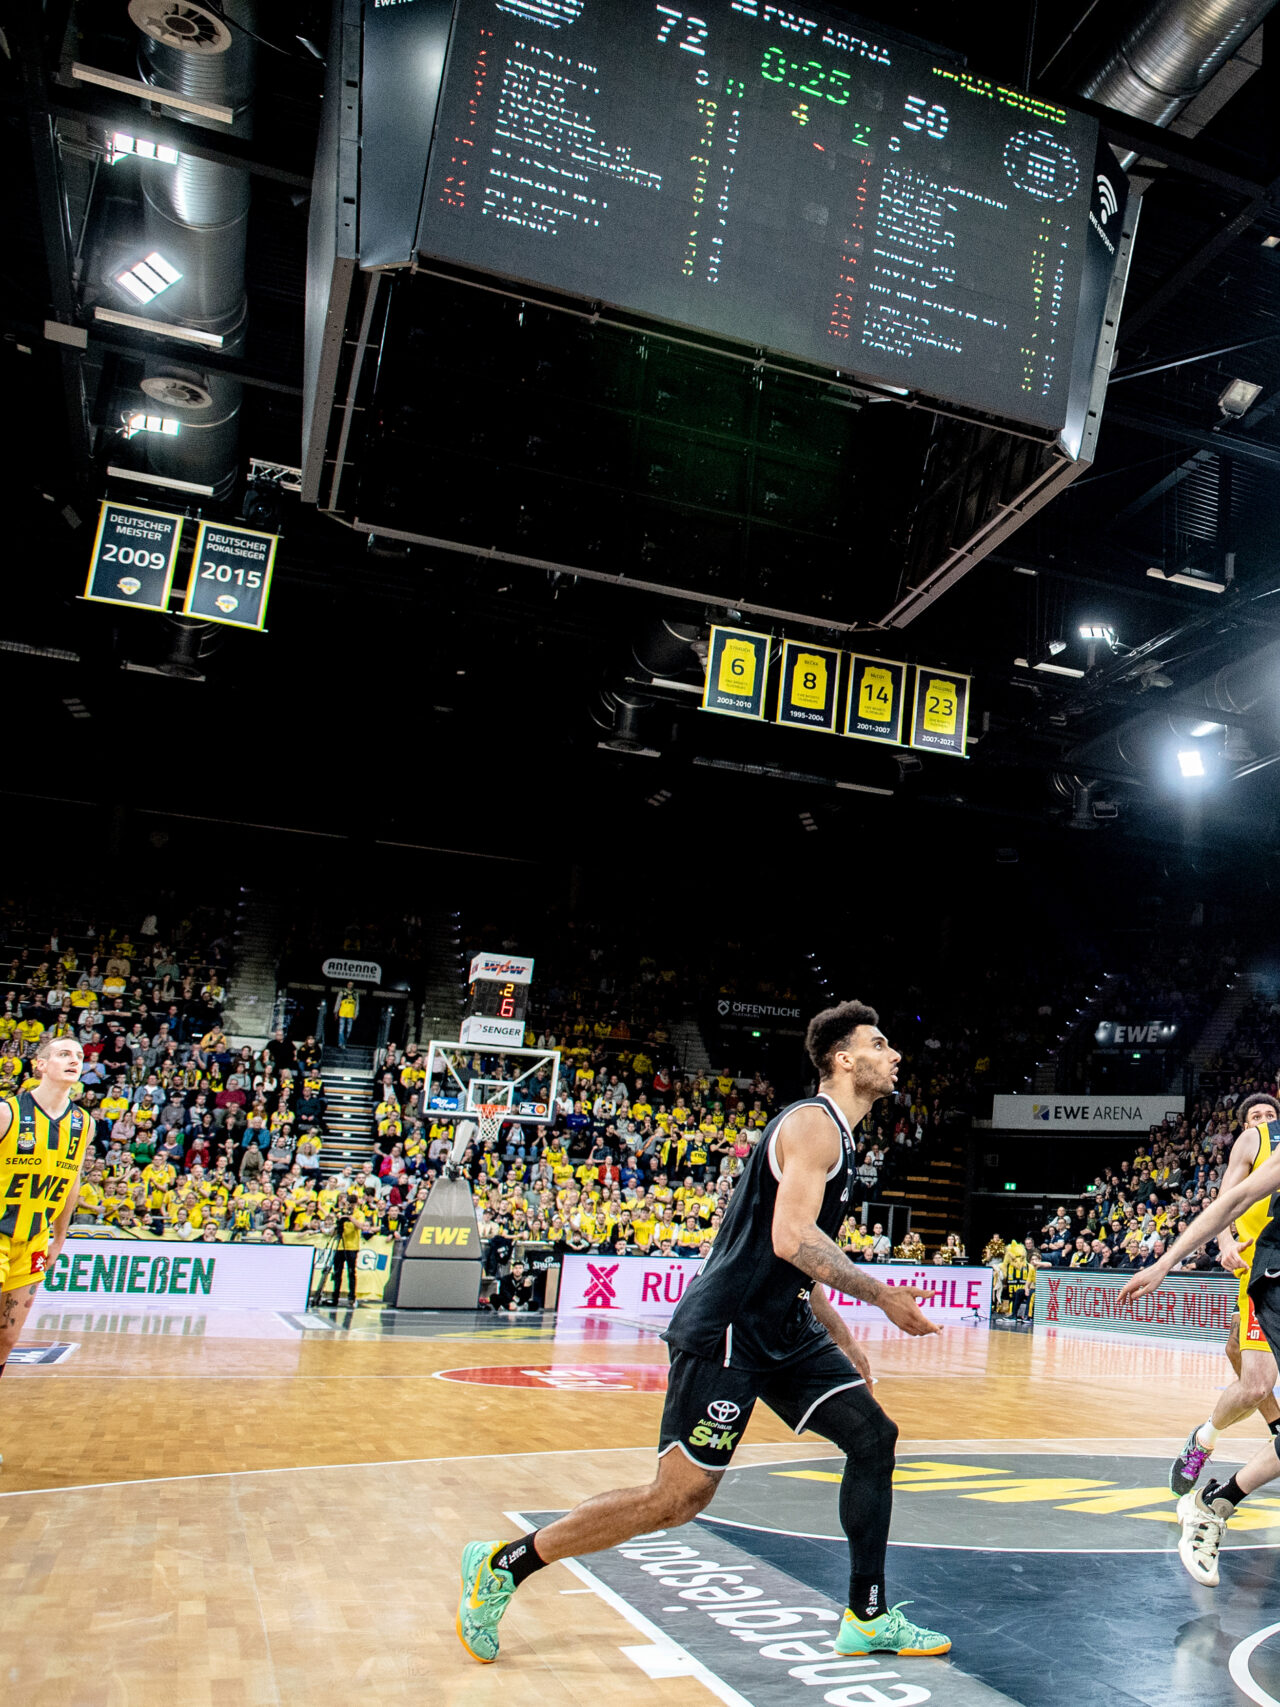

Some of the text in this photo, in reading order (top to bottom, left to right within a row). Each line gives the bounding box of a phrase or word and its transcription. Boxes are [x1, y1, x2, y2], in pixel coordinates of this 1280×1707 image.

[110, 513, 172, 533] DEUTSCHER
[116, 525, 163, 541] MEISTER
[206, 542, 266, 561] POKALSIEGER
[208, 532, 267, 552] DEUTSCHER
[102, 544, 165, 570] 2009
[200, 562, 263, 588] 2015
[731, 658, 745, 676] 6
[803, 672, 817, 690] 8
[864, 684, 889, 704] 14
[928, 696, 953, 716] 23
[857, 722, 891, 734] 2001-2007
[482, 1025, 521, 1036] SENGER
[1113, 1025, 1159, 1043] EWE
[1053, 1105, 1143, 1121] EWE ARENA
[68, 1136, 79, 1156] 5
[5, 1157, 43, 1166] SEMCO
[4, 1173, 70, 1202] EWE
[419, 1226, 471, 1246] EWE
[698, 1417, 732, 1431] Autohaus
[689, 1425, 739, 1451] S+K
[868, 1584, 879, 1606] CRAFT
